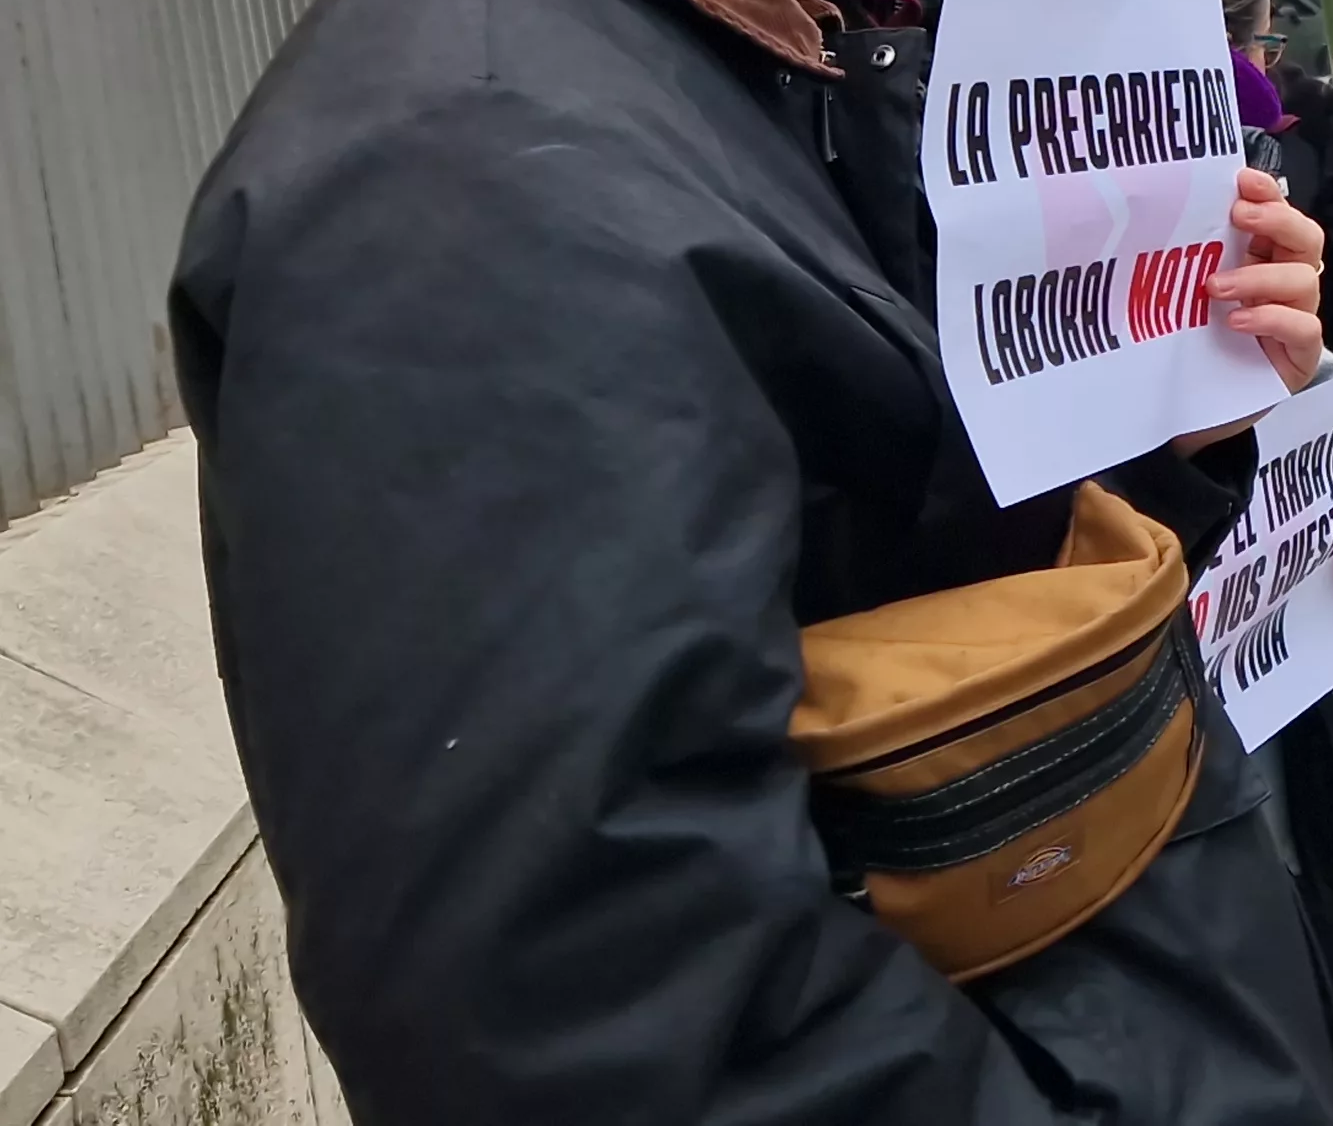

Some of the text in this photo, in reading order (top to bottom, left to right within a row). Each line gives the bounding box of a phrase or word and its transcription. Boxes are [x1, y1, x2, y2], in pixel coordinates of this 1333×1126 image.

[946, 67, 1240, 186] LA PRECARIEDAD
[973, 240, 1226, 387] LABORAL MATA
[1188, 590, 1210, 640] O
[1210, 554, 1268, 645] NOS
[1205, 599, 1290, 705] A VIDA
